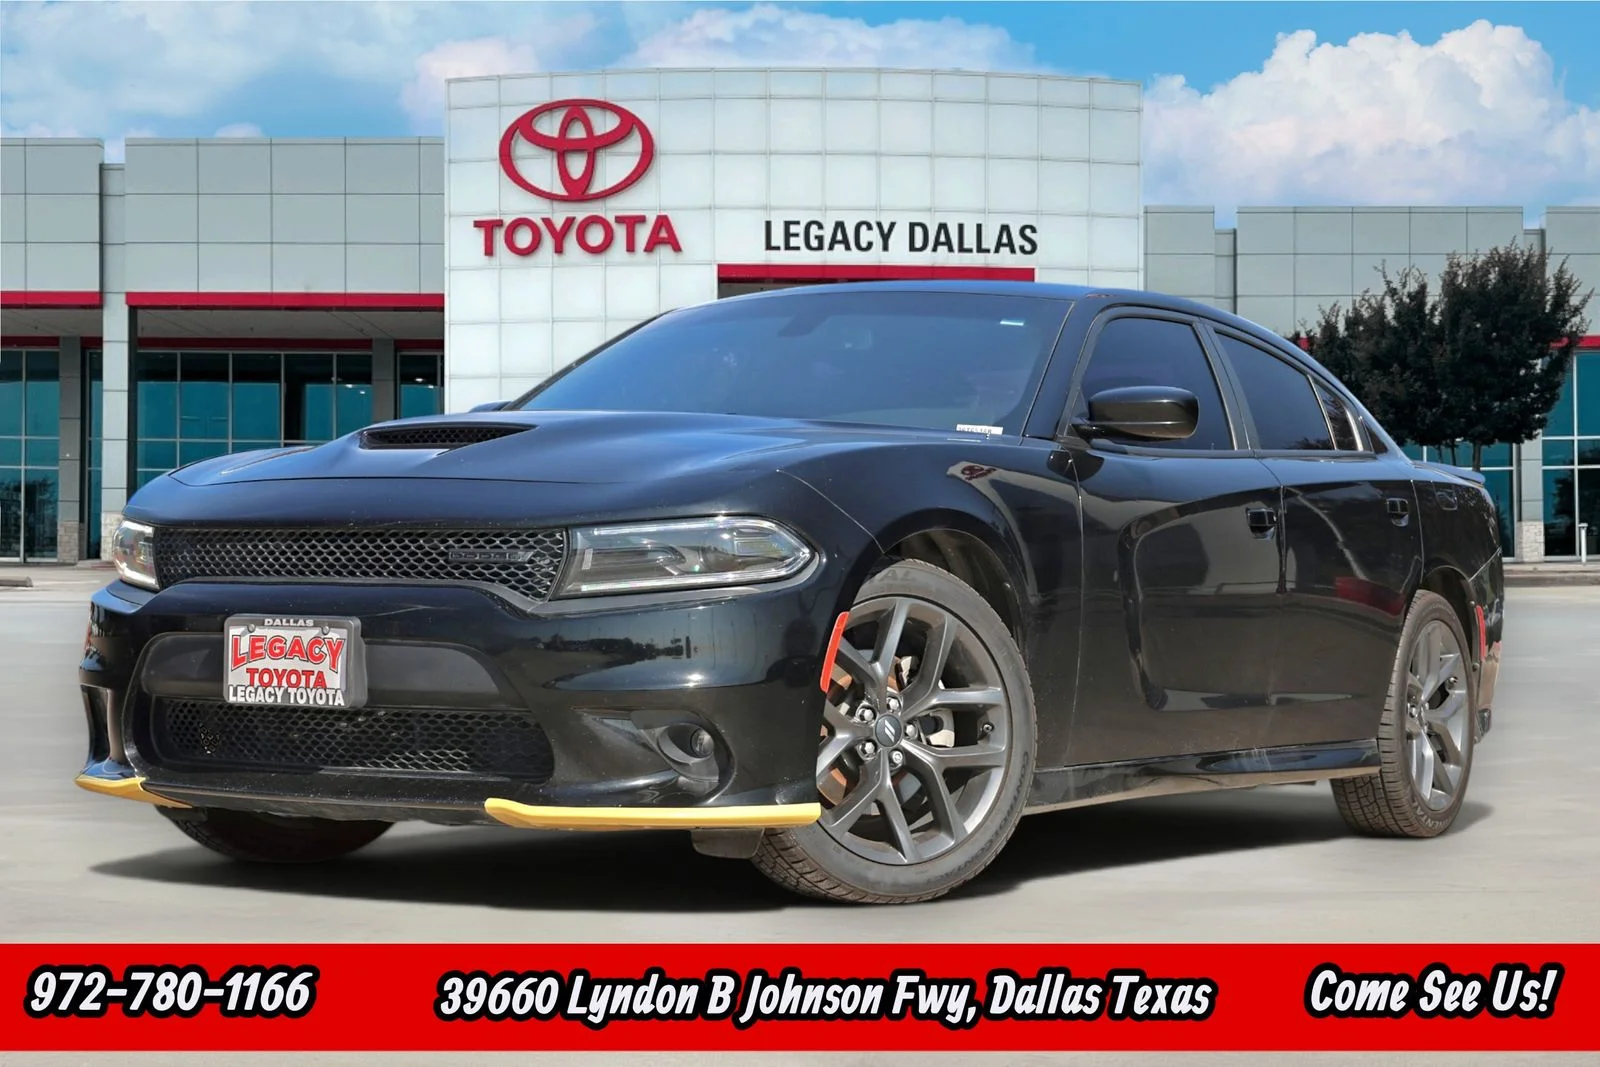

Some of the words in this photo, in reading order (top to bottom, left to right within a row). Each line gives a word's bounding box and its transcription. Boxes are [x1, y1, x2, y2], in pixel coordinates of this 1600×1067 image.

[474, 214, 682, 256] TOYOTA
[765, 220, 897, 252] LEGACY
[908, 221, 1038, 255] DALLAS
[263, 618, 315, 627] DALLAS
[231, 635, 346, 674] LEGACY
[246, 667, 327, 689] TOYOTA
[228, 685, 285, 703] LEGACY
[287, 686, 345, 706] TOYOTA
